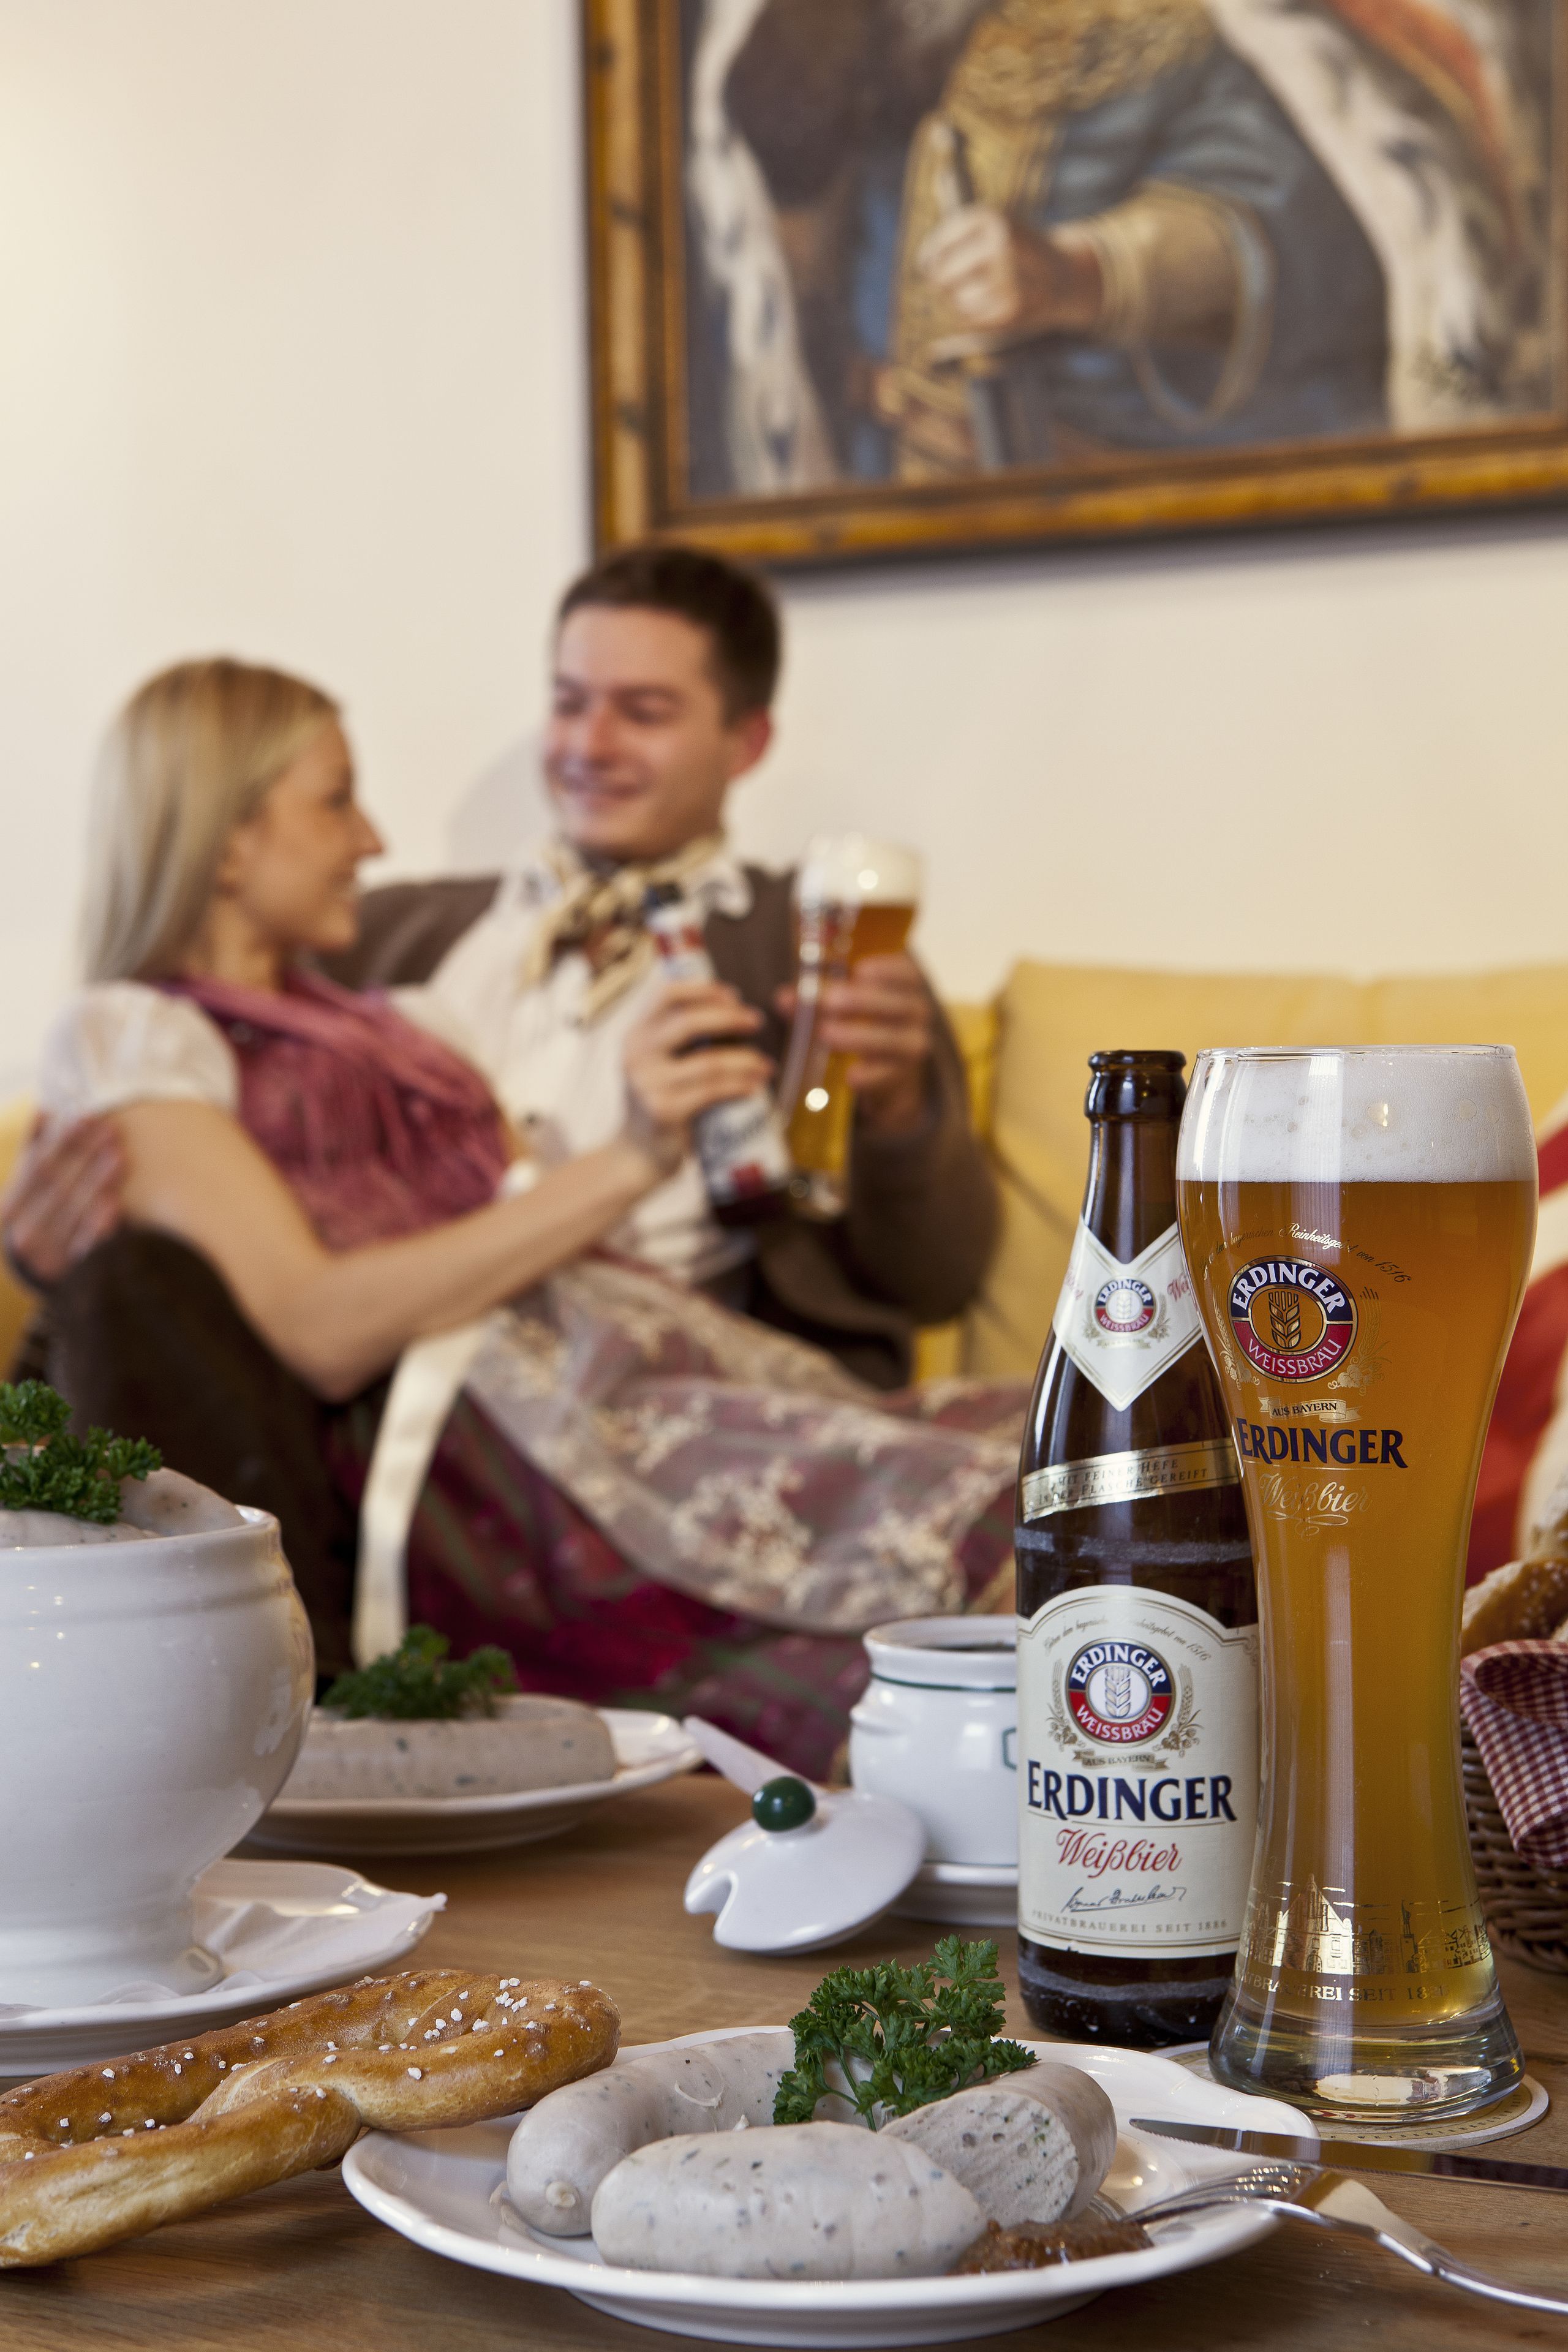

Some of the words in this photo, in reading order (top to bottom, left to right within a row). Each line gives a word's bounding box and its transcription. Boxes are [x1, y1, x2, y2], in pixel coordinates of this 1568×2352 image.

[1356, 1251, 1375, 1263] von
[1375, 1261, 1412, 1283] 1516
[1098, 1279, 1152, 1303] ERDINGER
[1232, 1263, 1345, 1314] ERDINGER
[1248, 1338, 1342, 1374] WEISSBRÄU
[1272, 1408, 1290, 1417] AUS
[1292, 1403, 1337, 1414] BAYERN
[1236, 1417, 1408, 1468] ERDINGER
[1141, 1459, 1178, 1473] HEFE
[1150, 1468, 1207, 1485] GEREIFT
[1259, 1472, 1373, 1518] Weißbier
[1071, 1644, 1167, 1687] ERDINGER
[1077, 1705, 1164, 1741] WEISSBRÄU
[1108, 1754, 1151, 1765] BAYERN
[1027, 1759, 1237, 1822] ERDINGER
[1056, 1828, 1183, 1879] Weißbier
[1032, 1909, 1147, 1933] PRIVATBRAUEREI
[1156, 1922, 1191, 1933] SEIT
[1349, 1987, 1395, 2001] SEIT
